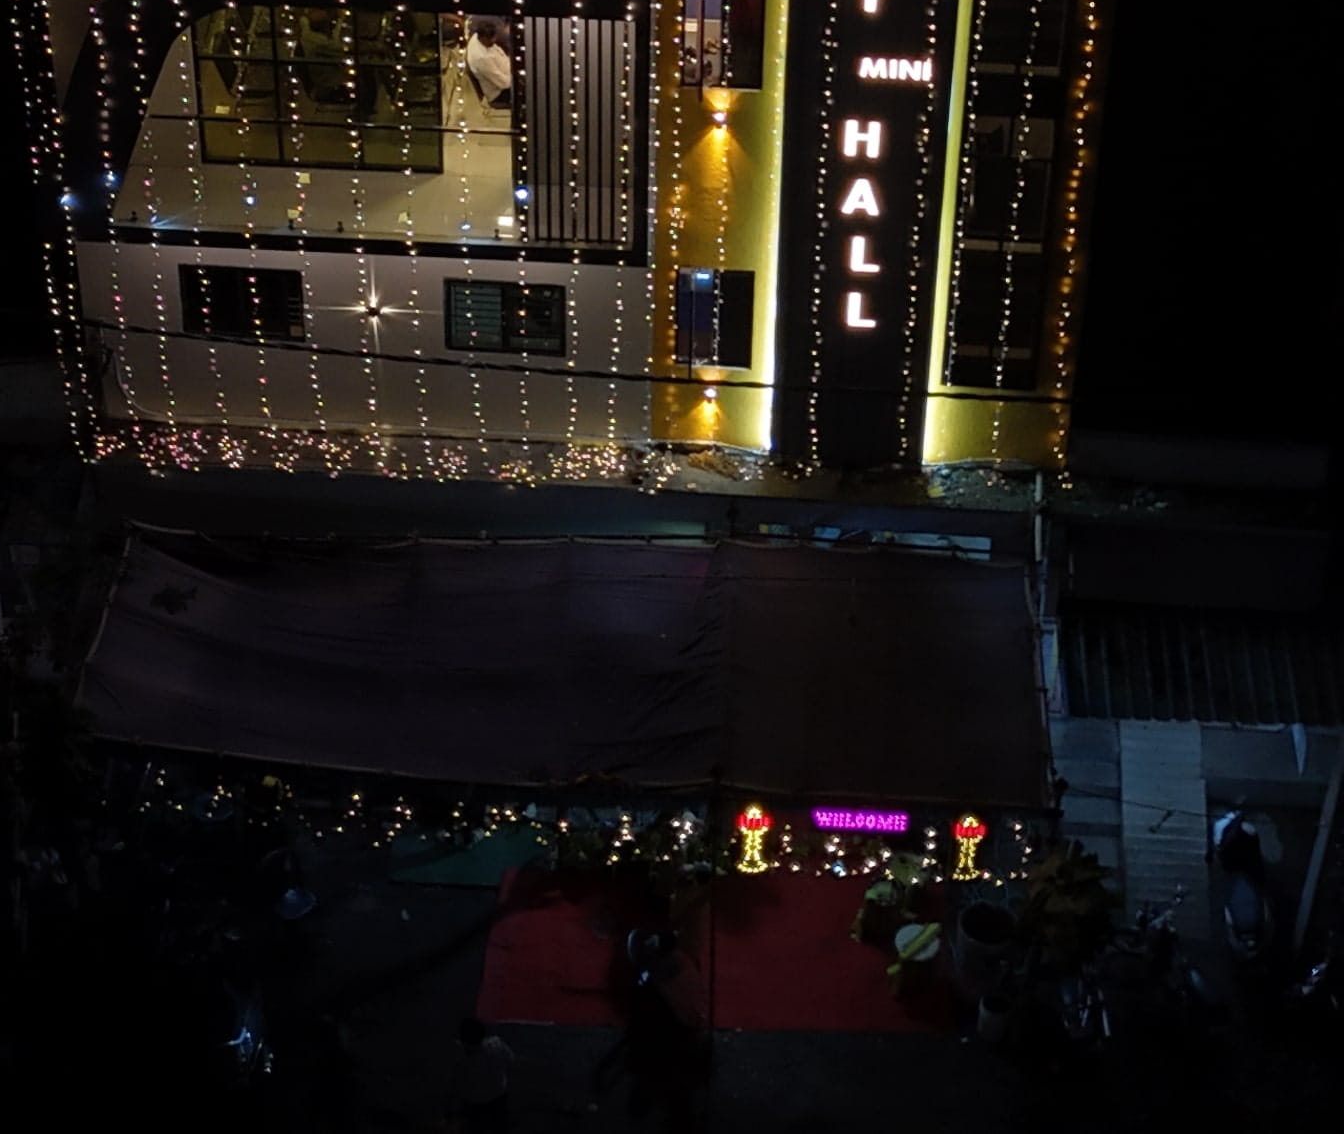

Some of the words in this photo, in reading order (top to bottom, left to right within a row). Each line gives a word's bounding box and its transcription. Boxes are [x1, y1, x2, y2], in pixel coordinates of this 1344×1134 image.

[859, 57, 932, 82] MINI
[840, 119, 882, 328] HALL
[815, 810, 908, 832] WELCOME
